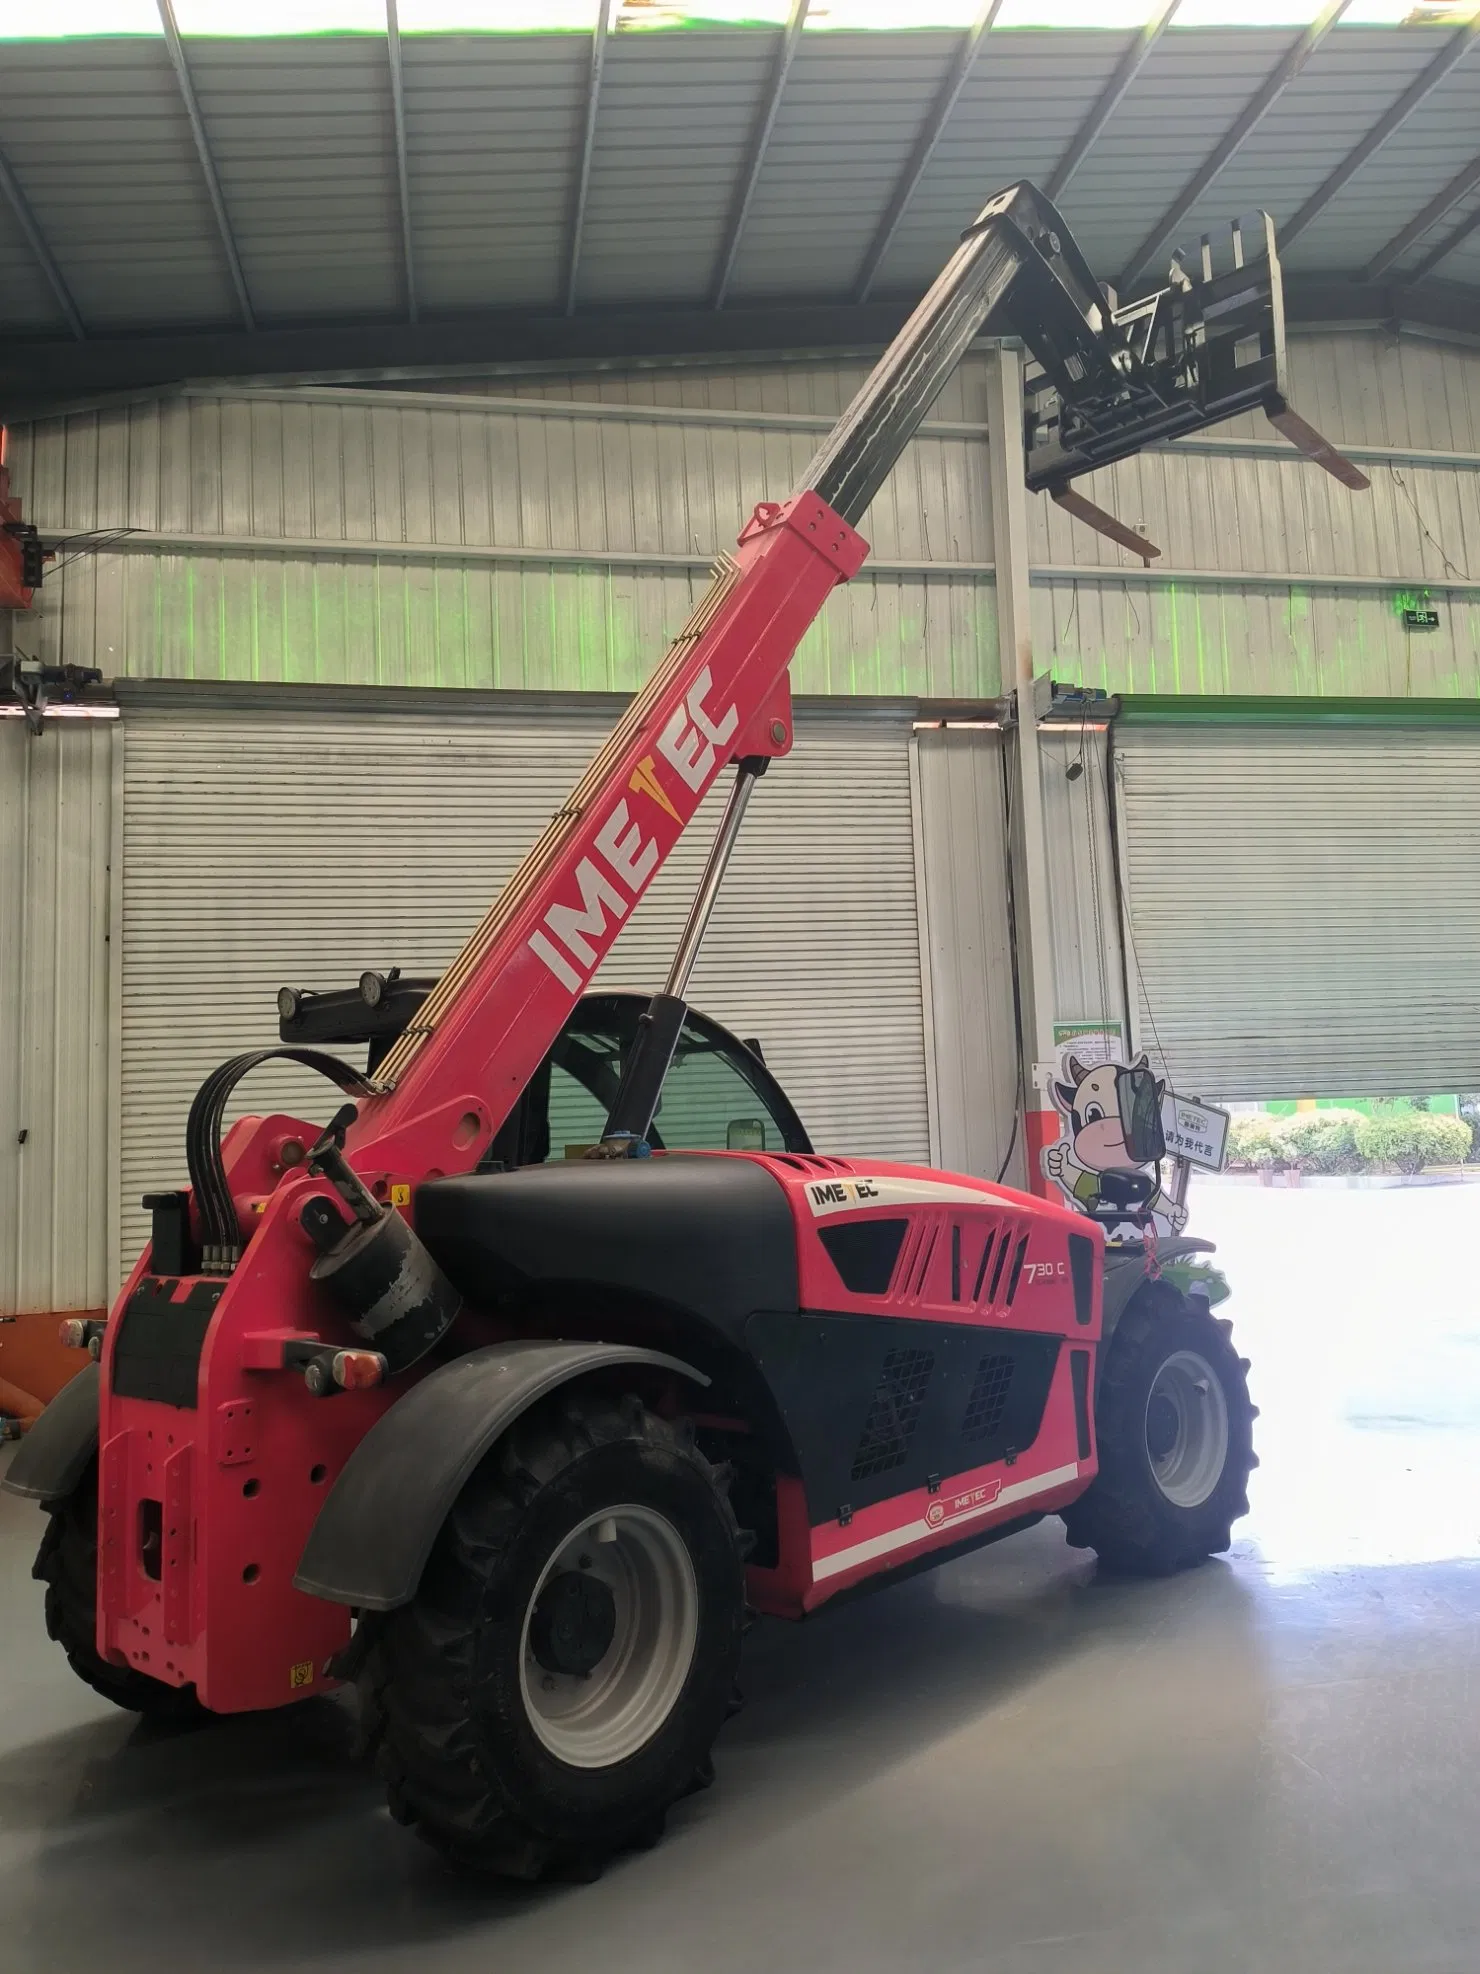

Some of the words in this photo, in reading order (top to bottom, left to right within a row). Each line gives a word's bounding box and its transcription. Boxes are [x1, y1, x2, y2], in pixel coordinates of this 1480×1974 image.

[527, 664, 739, 995] IMETEC
[1165, 1129, 1214, 1157] 请为我代言
[810, 1179, 879, 1206] IMETEC
[1023, 1262, 1054, 1285] 730
[1057, 1262, 1065, 1275] C
